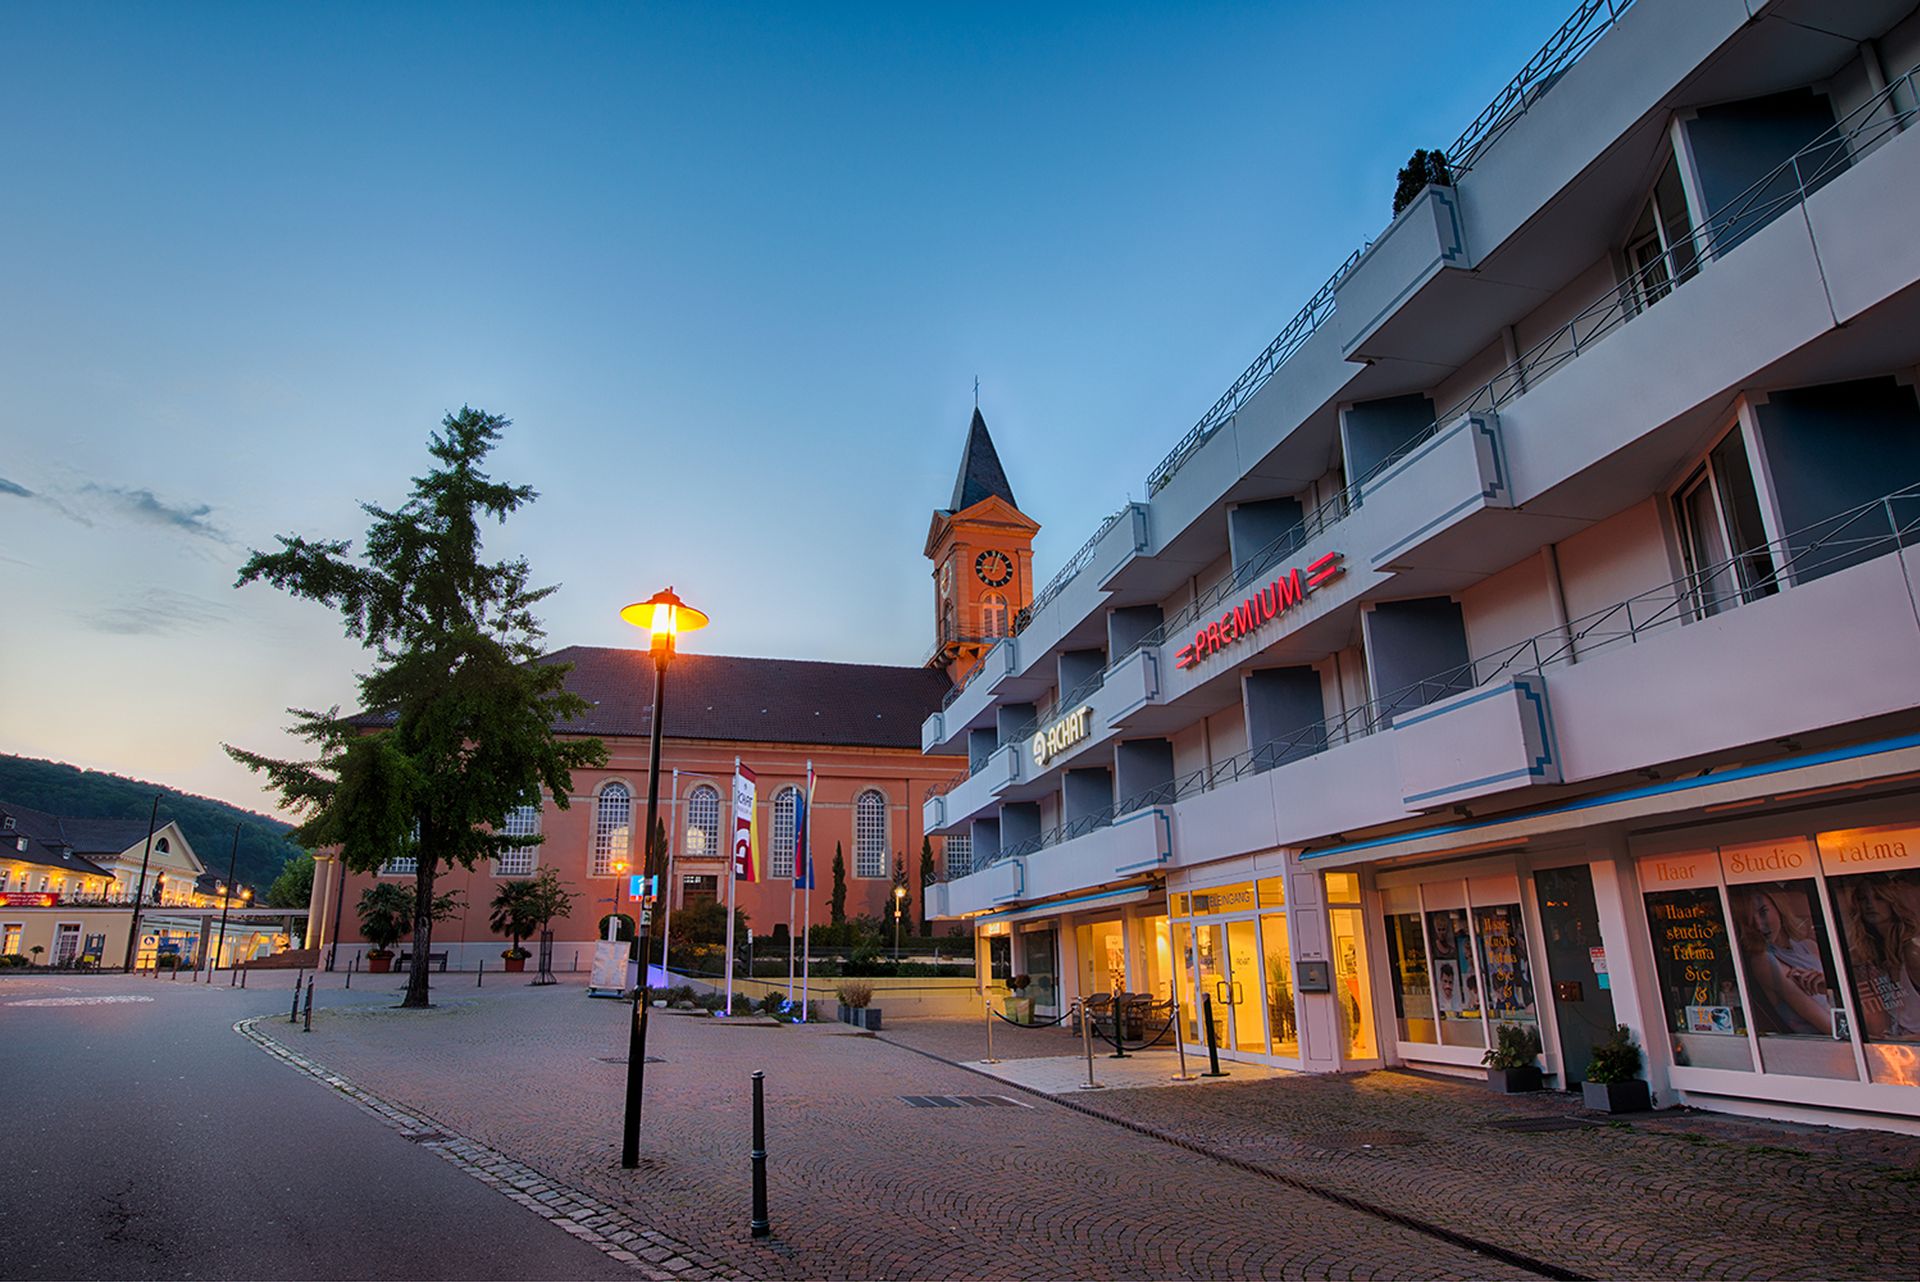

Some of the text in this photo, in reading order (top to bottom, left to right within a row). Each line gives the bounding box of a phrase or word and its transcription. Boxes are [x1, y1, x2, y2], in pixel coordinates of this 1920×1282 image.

[1195, 567, 1303, 662] PREMIUM
[1047, 705, 1087, 756] ACHAT
[1656, 862, 1697, 882] Haar
[1730, 848, 1803, 874] Studio
